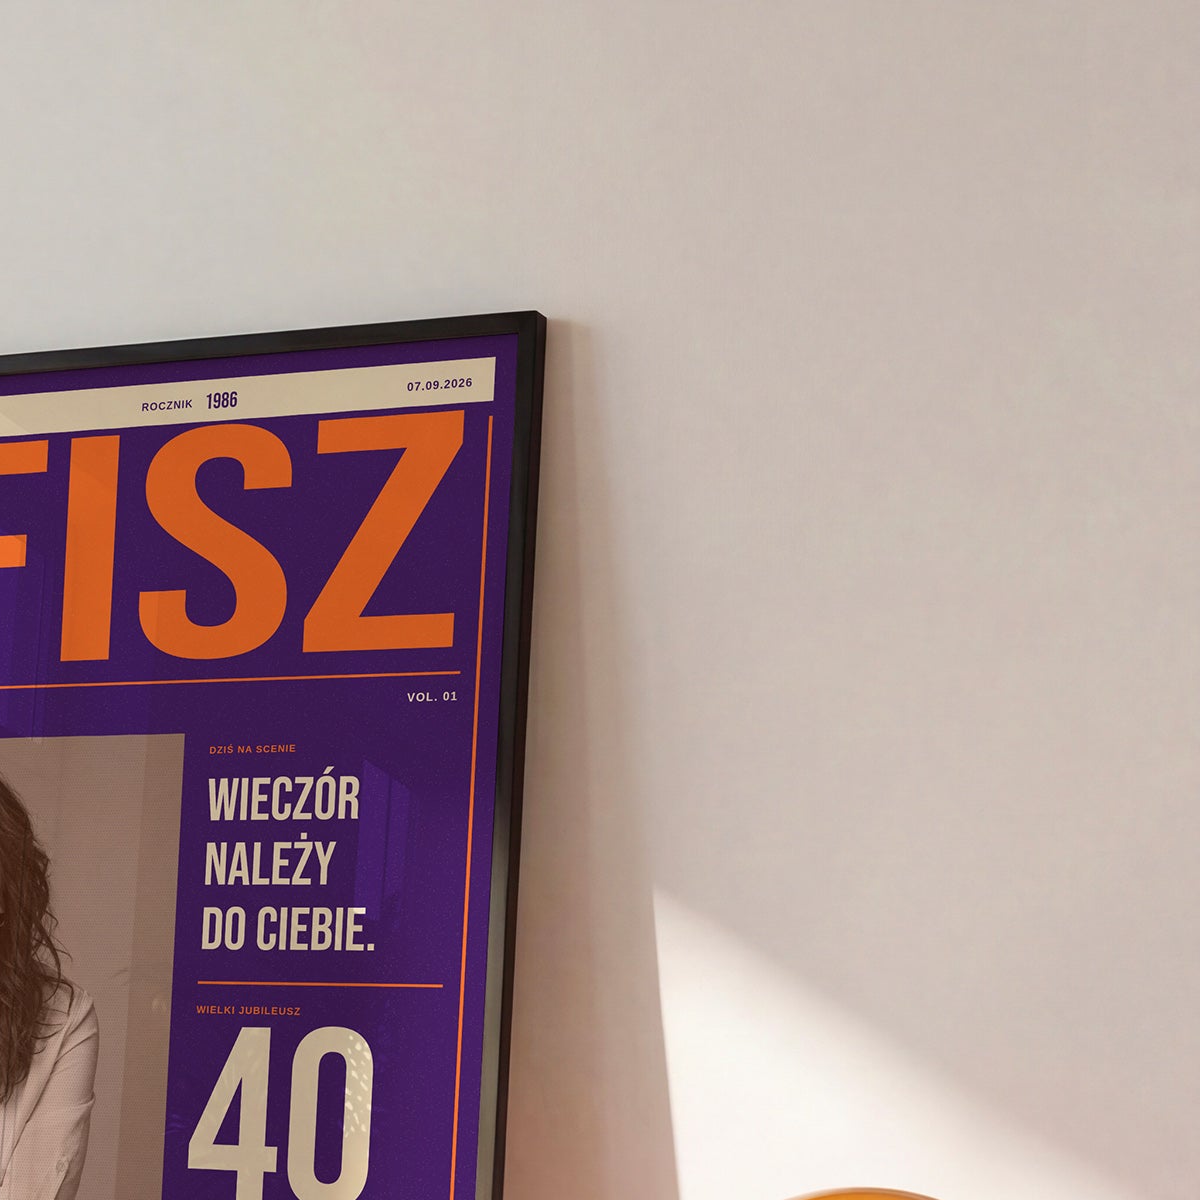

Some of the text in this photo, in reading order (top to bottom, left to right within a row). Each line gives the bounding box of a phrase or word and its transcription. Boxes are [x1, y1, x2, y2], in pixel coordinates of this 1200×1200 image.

[407, 378, 472, 392] 07.09.2026
[142, 391, 238, 412] ROCZNIK 1986
[407, 691, 457, 702] VOL. 01
[209, 744, 296, 754] DZIŚ NA SCENIE
[208, 766, 359, 821] WIECZÓR
[205, 832, 337, 885] NALEŻY
[201, 906, 375, 951] DO CIEBIE.
[196, 1005, 300, 1016] WIELKI JUBILEUSZ
